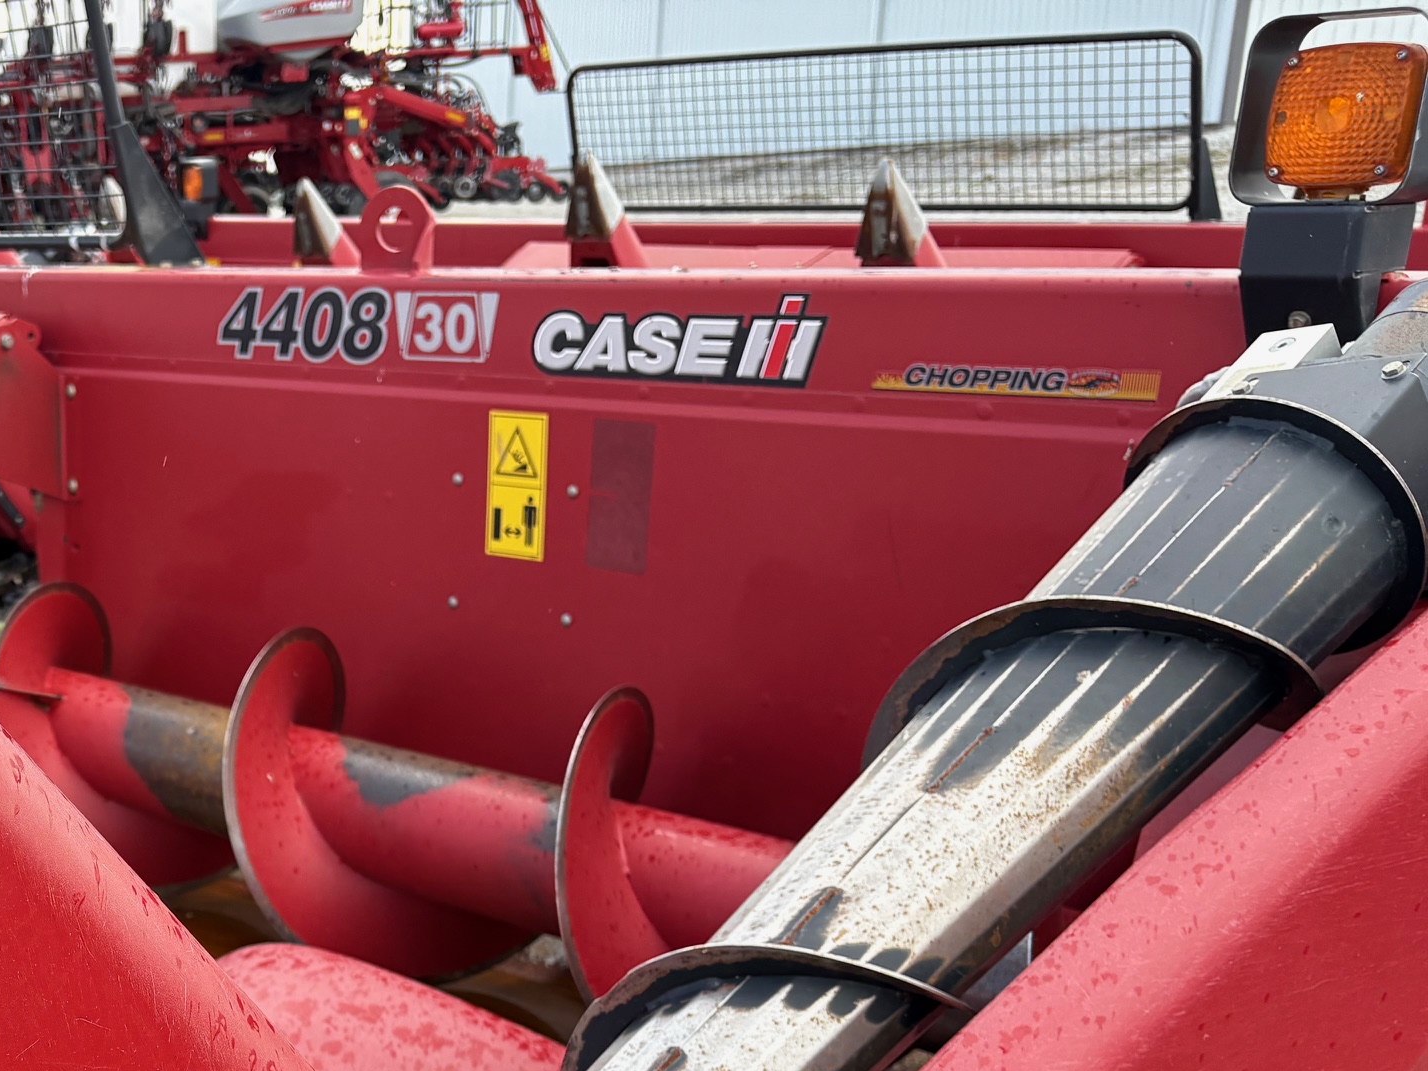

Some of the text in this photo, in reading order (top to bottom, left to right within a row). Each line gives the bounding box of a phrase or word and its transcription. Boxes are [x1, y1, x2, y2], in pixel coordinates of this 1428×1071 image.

[218, 287, 477, 364] 4408 30
[533, 310, 740, 377] CASE
[904, 364, 1067, 393] CHOPPING
